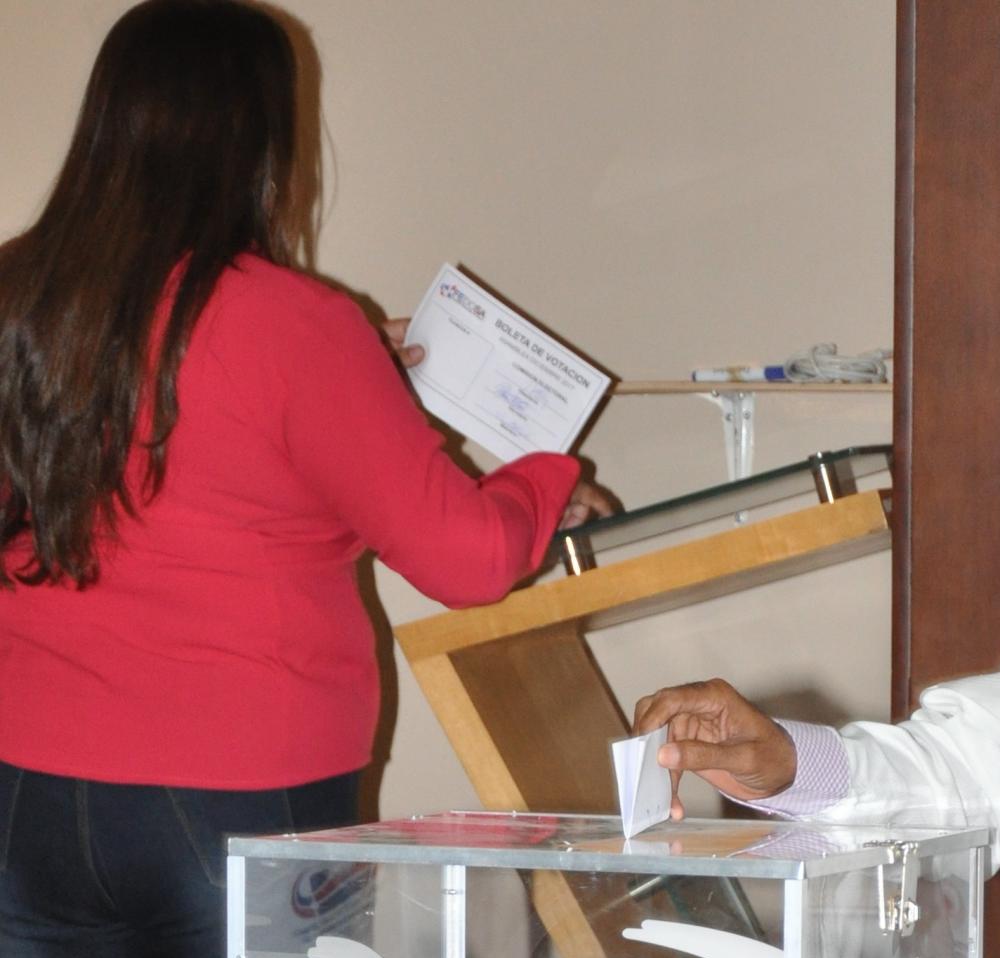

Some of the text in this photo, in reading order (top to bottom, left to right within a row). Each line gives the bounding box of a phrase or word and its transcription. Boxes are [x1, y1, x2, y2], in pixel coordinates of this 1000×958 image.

[494, 319, 531, 348] BOLETA
[530, 343, 545, 358] DE
[544, 352, 591, 389] VOTACION
